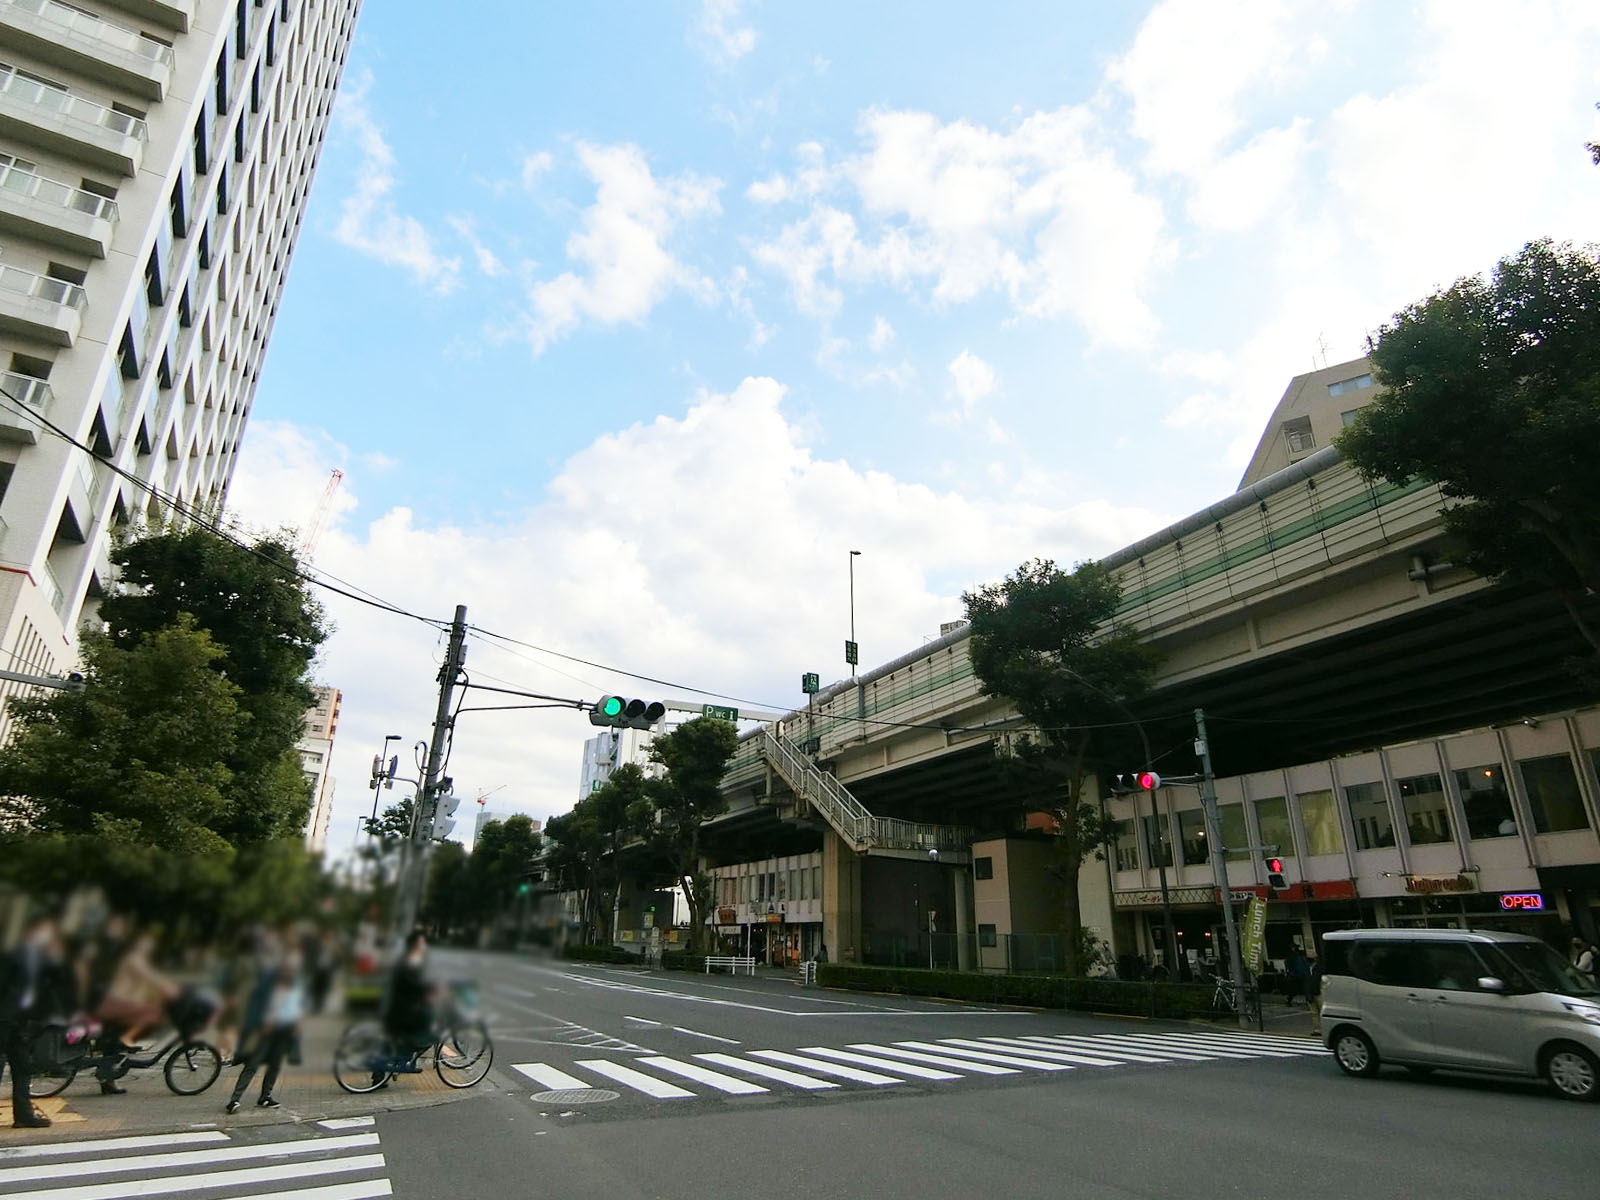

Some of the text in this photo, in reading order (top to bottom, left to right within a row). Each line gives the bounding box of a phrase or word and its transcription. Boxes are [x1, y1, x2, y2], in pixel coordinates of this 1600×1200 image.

[706, 705, 713, 718] P
[1503, 896, 1540, 908] OPEN
[1249, 902, 1265, 971] Lunch Time
